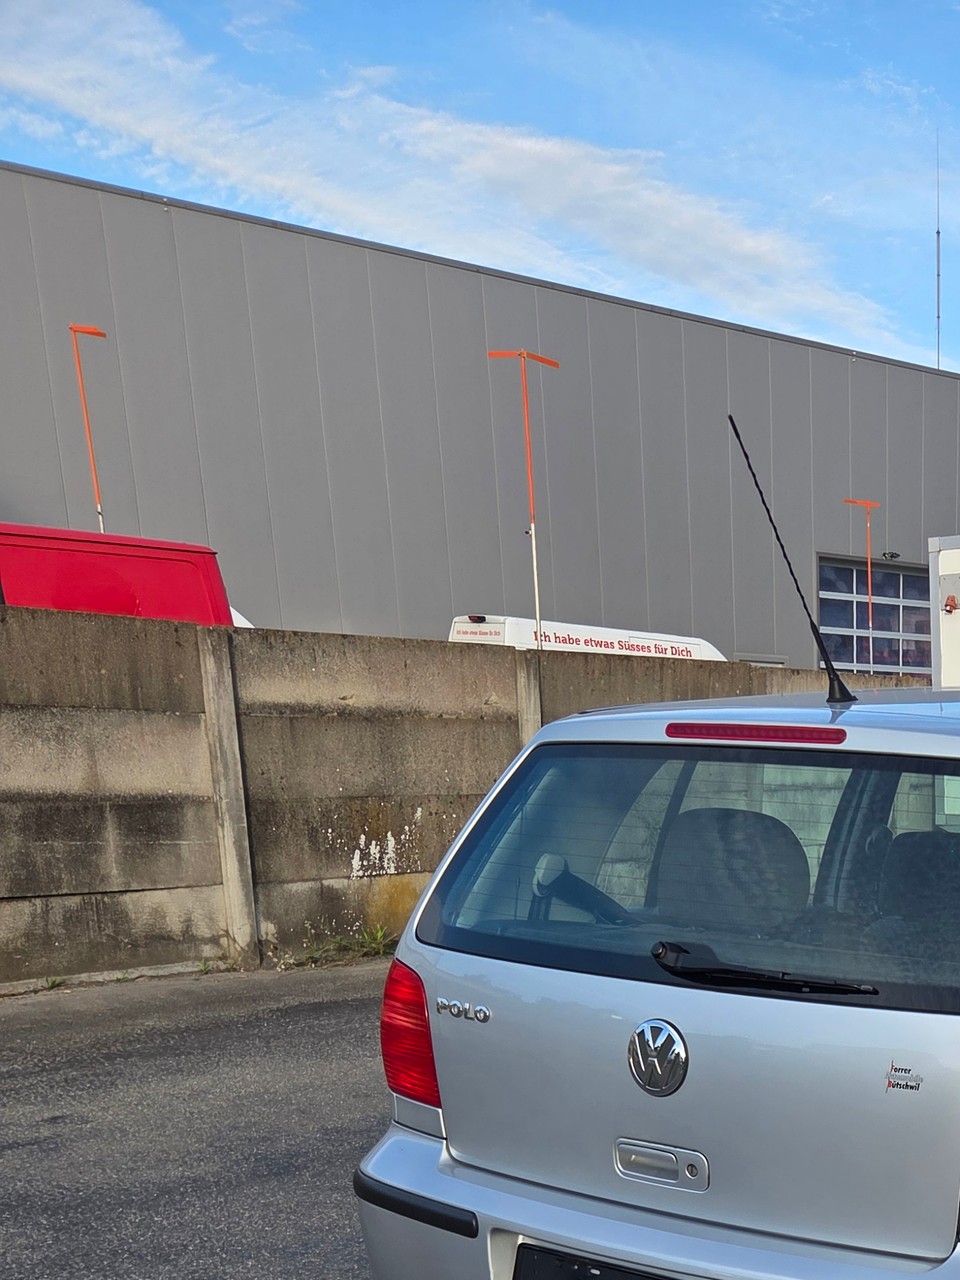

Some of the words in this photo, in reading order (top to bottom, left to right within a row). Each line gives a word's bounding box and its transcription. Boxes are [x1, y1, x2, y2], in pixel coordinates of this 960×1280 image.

[554, 632, 581, 646] habe
[584, 637, 615, 650] etwas
[618, 640, 652, 654] Süsses
[654, 643, 669, 656] für
[670, 645, 693, 658] Dich
[436, 997, 491, 1023] POLO
[628, 1019, 689, 1097] VW
